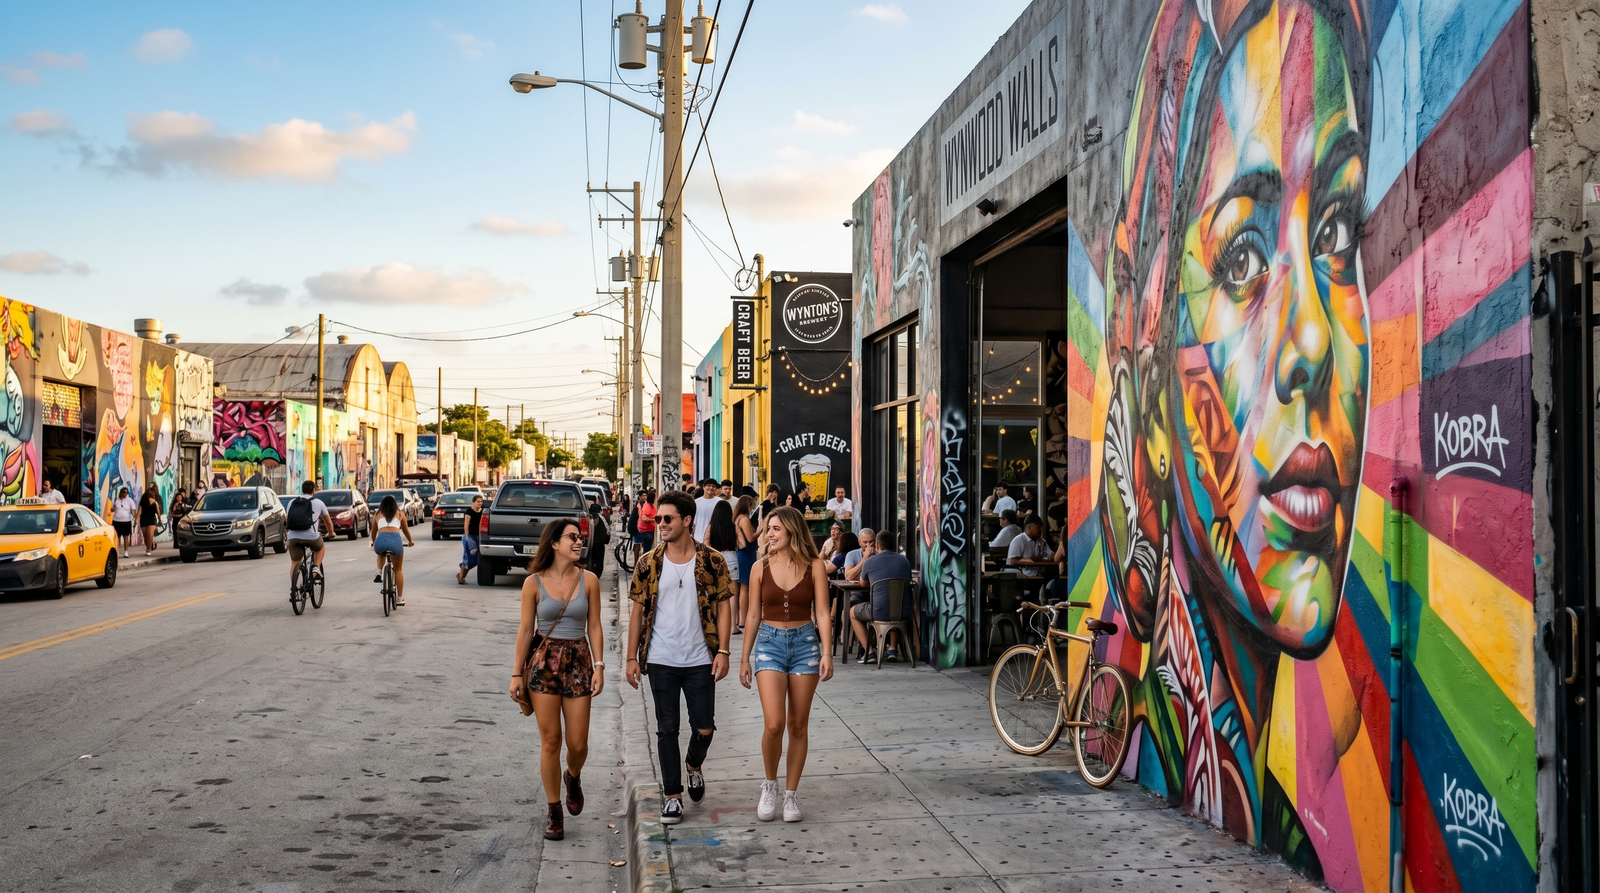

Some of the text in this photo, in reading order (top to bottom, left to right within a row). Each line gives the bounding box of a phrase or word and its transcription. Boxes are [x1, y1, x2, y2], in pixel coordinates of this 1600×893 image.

[944, 35, 1058, 207] WYNWOOD WALLS
[737, 304, 751, 379] CRAFT BEER
[787, 300, 839, 322] WYNTON'S
[1434, 404, 1509, 469] KOBRA
[1443, 772, 1506, 847] KOBRA
